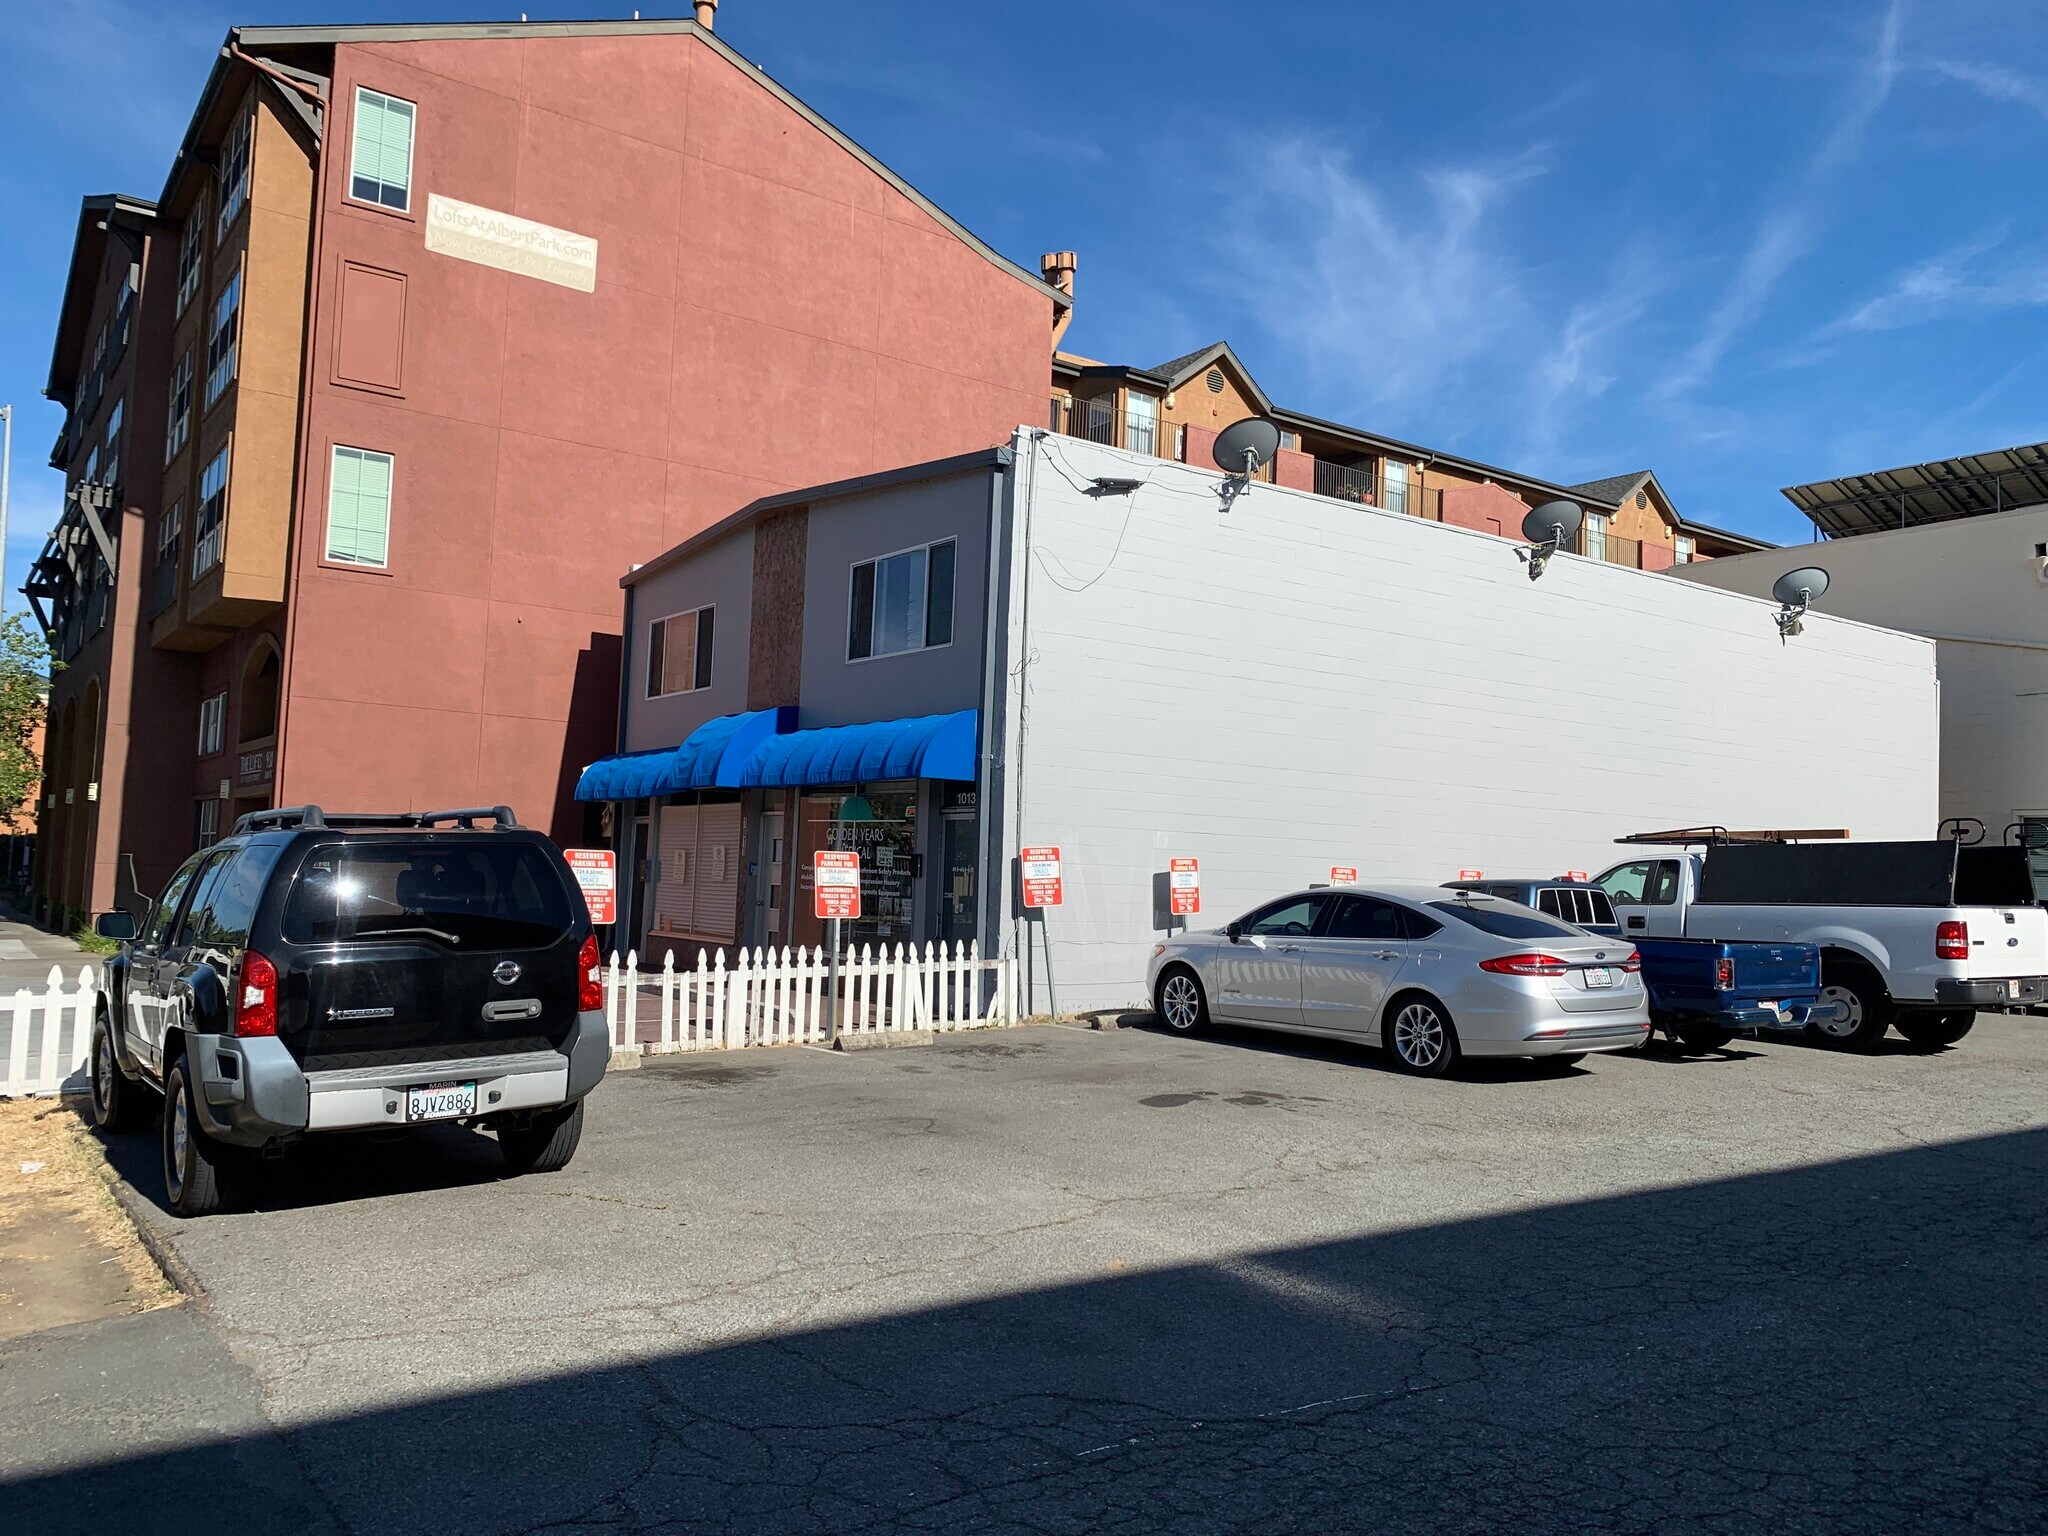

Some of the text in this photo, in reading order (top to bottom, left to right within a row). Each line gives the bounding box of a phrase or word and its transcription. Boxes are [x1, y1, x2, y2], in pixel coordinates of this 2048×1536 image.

[434, 204, 592, 261] LoftsAtAlbertPark.com
[434, 231, 589, 282] Now Leasing Pet Friendly
[957, 792, 976, 804] 1013
[826, 828, 884, 841] GODEN YEARS
[574, 852, 605, 860] RESERVED
[429, 1080, 457, 1089] MARIN
[412, 1092, 472, 1114] 8JVZ886
